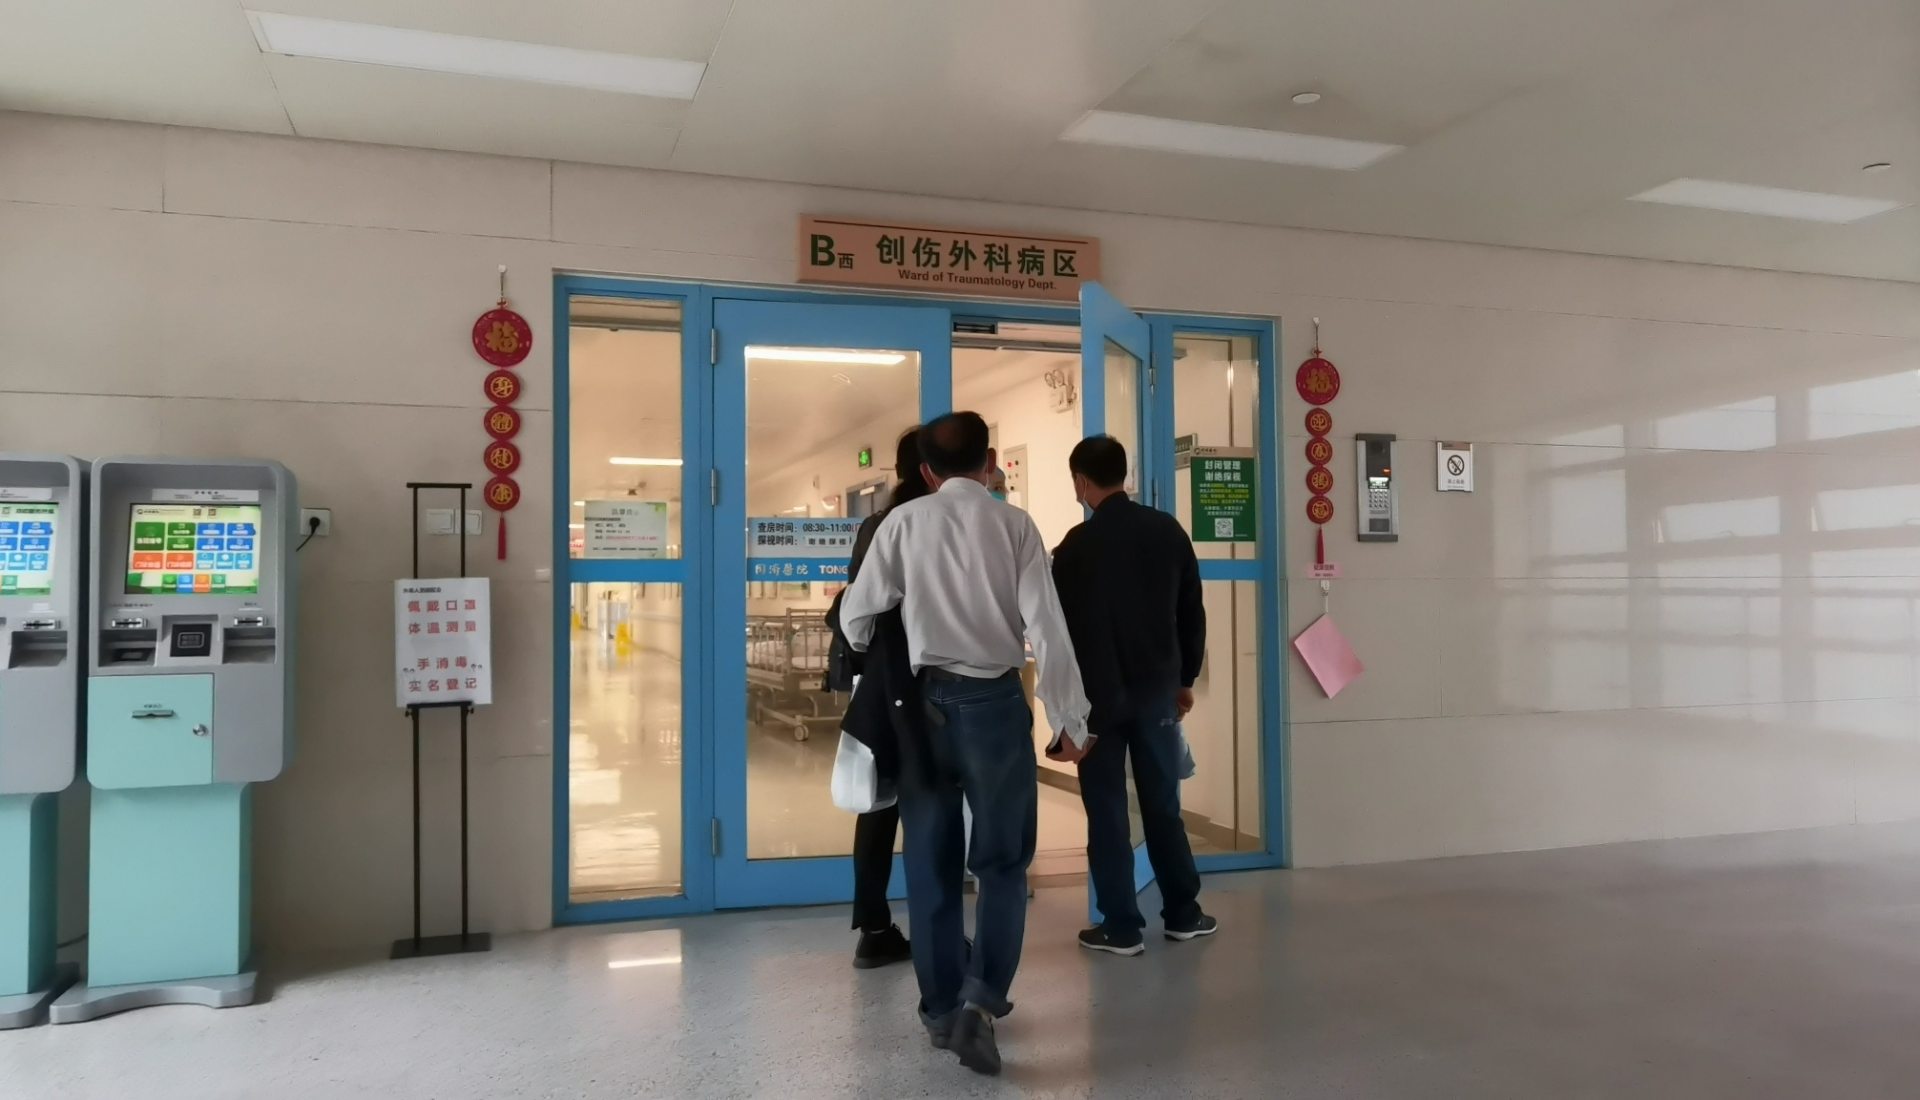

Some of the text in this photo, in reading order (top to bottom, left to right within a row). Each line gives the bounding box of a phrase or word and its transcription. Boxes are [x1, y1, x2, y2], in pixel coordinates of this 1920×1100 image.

[876, 234, 1079, 277] 创伤外科病区
[898, 269, 1058, 291] Ward of Traumatology Dept.
[485, 320, 519, 355] 福
[1204, 460, 1242, 470] 封闭管理
[407, 599, 477, 613] 佩戴口罩
[408, 620, 477, 635] 体温测量
[417, 656, 468, 671] 手消毒
[408, 677, 478, 693] 实名登记
